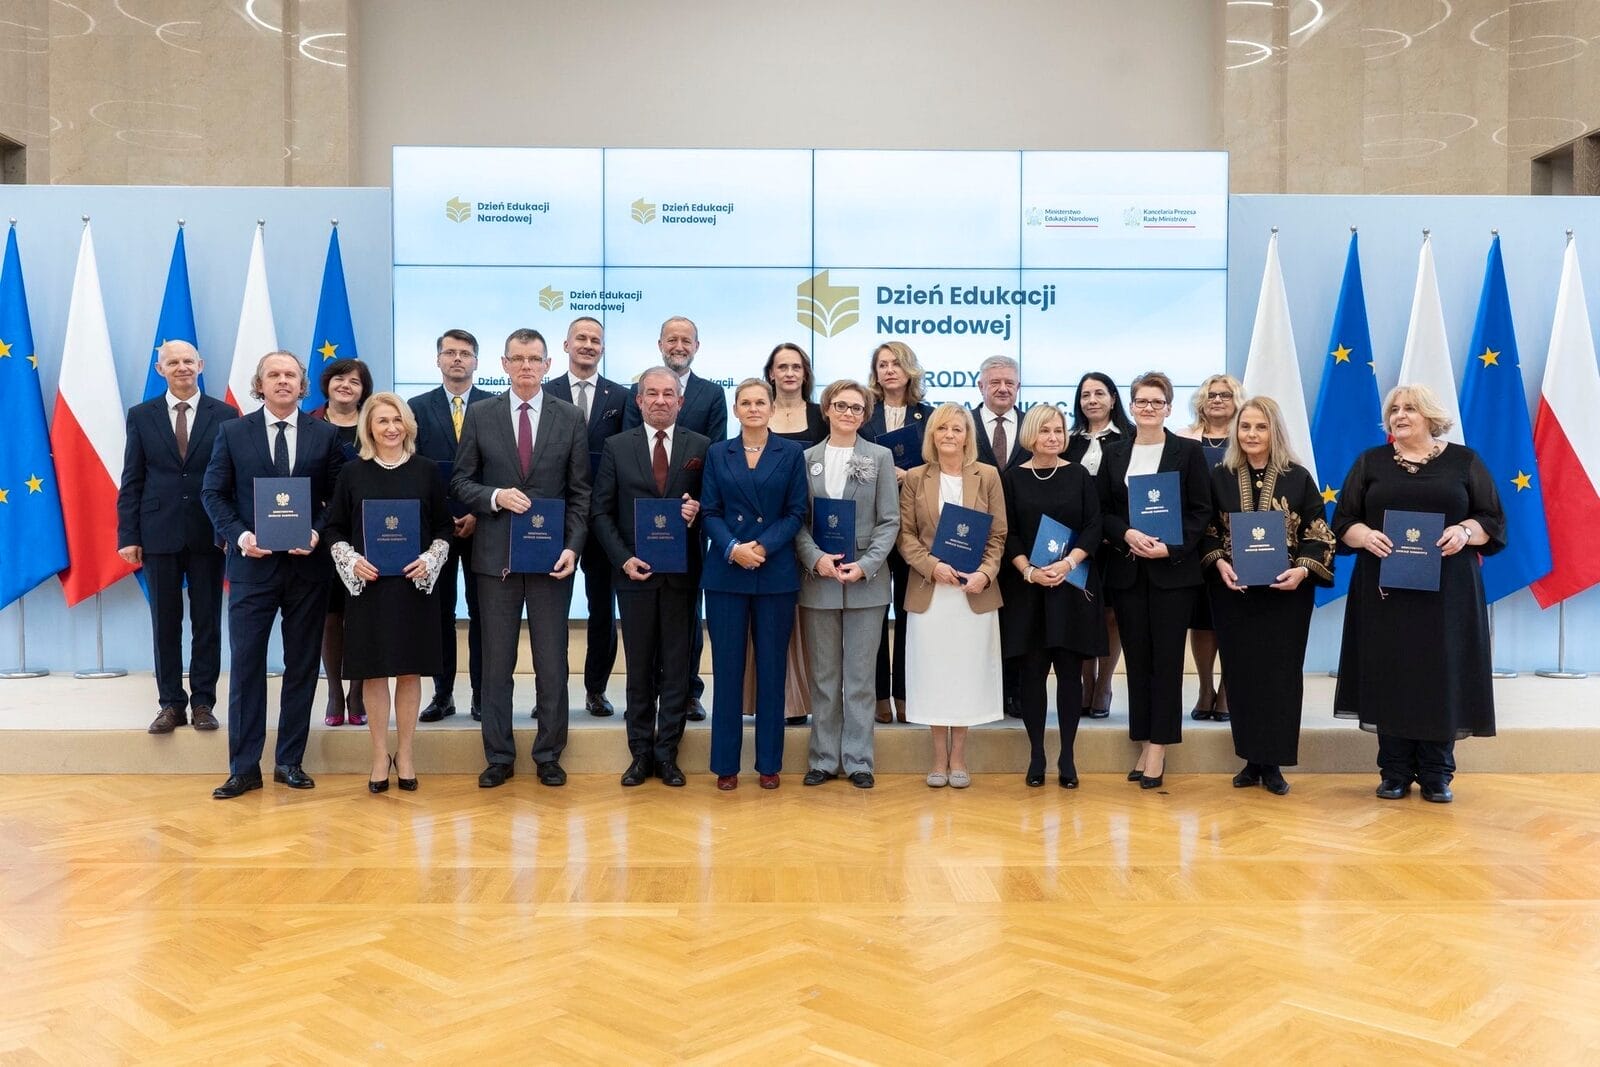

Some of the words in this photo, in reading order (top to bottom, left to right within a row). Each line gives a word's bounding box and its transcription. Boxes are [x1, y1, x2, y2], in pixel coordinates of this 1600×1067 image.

[477, 202, 505, 210] Dzień
[506, 202, 550, 213] Edukacji
[662, 203, 690, 212] Dzień
[691, 203, 734, 214] Edukacji
[477, 213, 532, 225] Narodowej
[662, 215, 716, 226] Narodowej
[570, 290, 597, 299] Dzień
[599, 290, 642, 301] Edukacji
[876, 284, 944, 305] Dzień
[950, 284, 1056, 312] Edukacji
[570, 302, 625, 313] Narodowej
[876, 313, 1011, 341] Narodowej
[478, 376, 505, 386] Dzień
[924, 371, 980, 388] RODY
